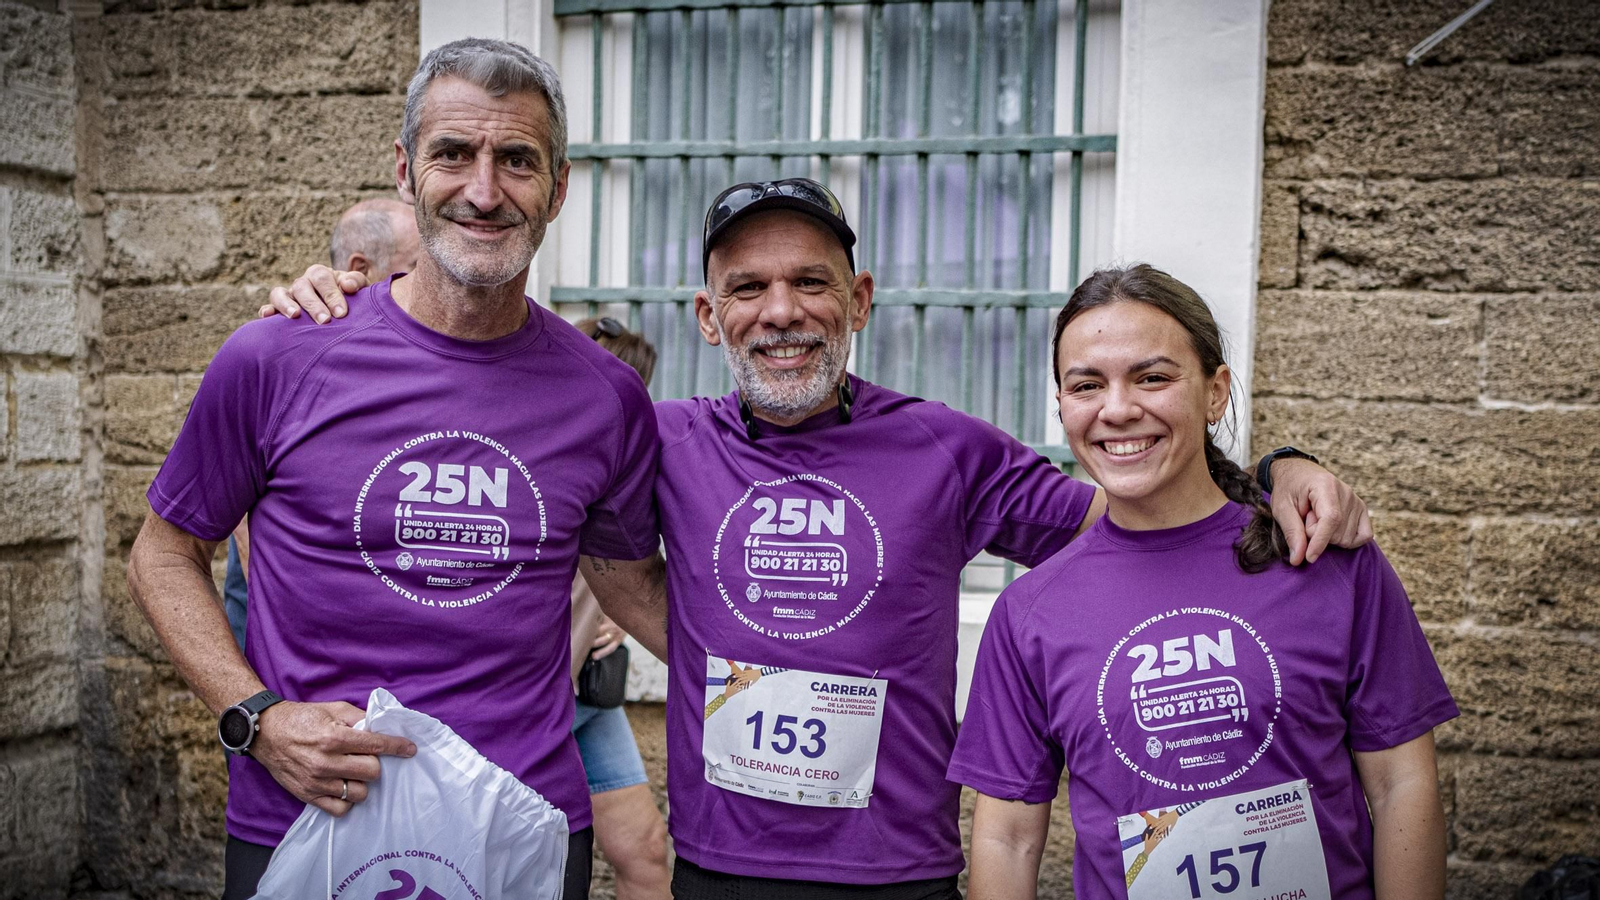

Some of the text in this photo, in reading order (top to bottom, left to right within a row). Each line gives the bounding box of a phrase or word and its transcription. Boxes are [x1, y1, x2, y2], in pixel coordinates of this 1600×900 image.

[355, 448, 403, 512] INTERNACIONAL
[404, 432, 444, 449] CONTRA
[462, 431, 509, 457] VIOLENCIA
[510, 455, 532, 481] HACIA
[530, 481, 542, 499] LAS
[798, 474, 842, 491] VIOLENCIA
[398, 461, 508, 508] 25N
[844, 490, 865, 511] HACIA
[715, 486, 754, 542] INTERNACIONAL
[750, 497, 845, 535] 25N
[864, 511, 876, 526] LAS
[402, 528, 502, 545] 900 21 21 30
[712, 544, 720, 560] DÍA
[873, 528, 883, 568] MUJERES
[416, 557, 465, 568] Ayuntamiento
[751, 556, 841, 571] 900 21 21 30
[360, 551, 525, 608] CÁDIZ CONTRA LA VIOLENCIA MACHIS
[763, 590, 807, 599] Ayuntamiento
[818, 591, 838, 600] Cádiz
[717, 583, 875, 640] CÁDIZ CONTRA LA VIOLENCIA MACHISTA
[1181, 607, 1230, 619] VIOLENCIA
[1129, 614, 1164, 636] CONTRA
[1231, 615, 1256, 637] HACIA
[1255, 636, 1270, 653] LAS
[1127, 629, 1236, 683] 25N
[1097, 636, 1130, 706] INTERNACIONAL
[1266, 654, 1282, 698] MUJERES
[810, 682, 877, 697] CARRERA
[1140, 696, 1169, 706] UNIDAD
[1170, 691, 1198, 701] ALERTA
[1209, 686, 1236, 695] HORAS
[1098, 707, 1107, 725] DÍA
[1141, 694, 1239, 722] 900 21 21 30
[746, 710, 826, 758] 153
[1165, 729, 1243, 751] Ayuntamiento de Cádiz
[730, 754, 839, 780] TOLERANCIA CERO
[1114, 747, 1139, 772] CÁDIZ
[1140, 770, 1178, 790] CONTRA
[1197, 765, 1249, 790] VIOLENCIA
[1248, 722, 1274, 766] MACHISTA
[1235, 790, 1302, 814] CARRERA
[1269, 804, 1303, 817] ELIMINACIÓN
[1243, 826, 1269, 836] CONTRA
[1281, 817, 1307, 827] MUJERES
[1277, 810, 1305, 821] VIOLENCIA
[337, 850, 483, 900] INTERNACIONAL CONTRA LA VIOLENC
[1176, 841, 1267, 899] 157
